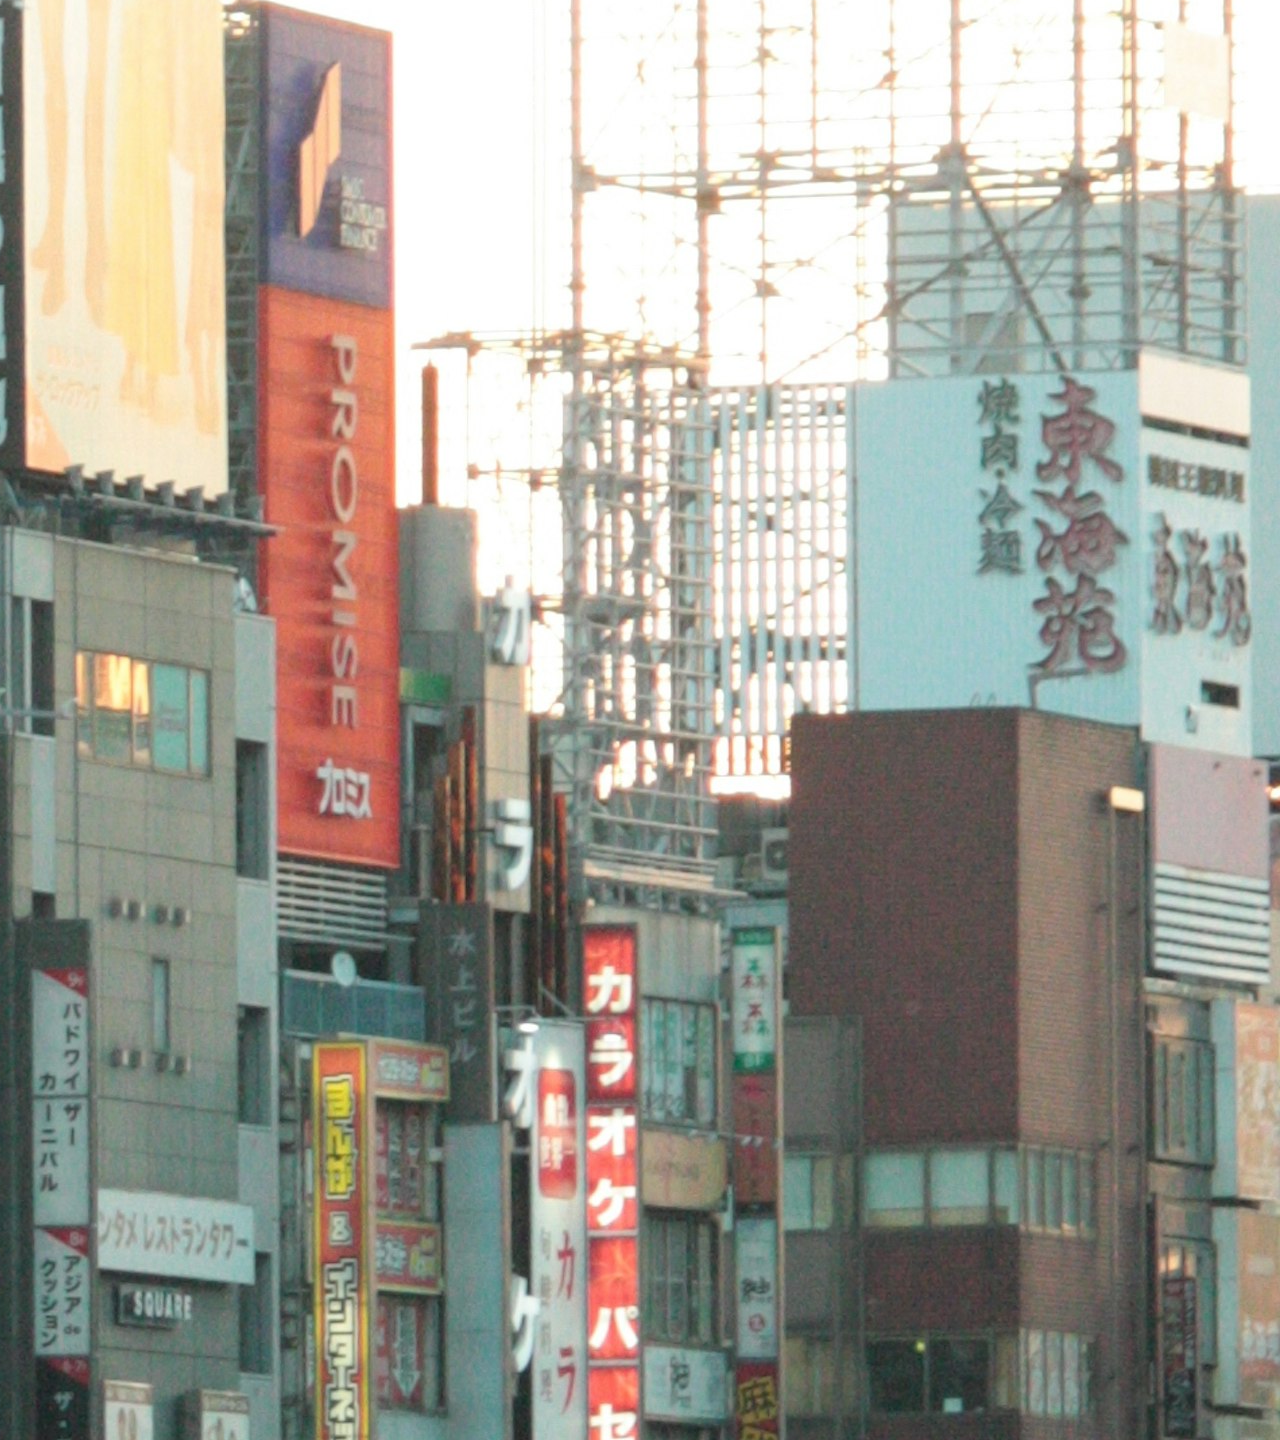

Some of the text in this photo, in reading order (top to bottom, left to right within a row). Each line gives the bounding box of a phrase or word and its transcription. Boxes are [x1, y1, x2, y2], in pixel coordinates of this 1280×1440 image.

[328, 332, 359, 731] PROMISE
[1032, 375, 1125, 674] 東海苑
[62, 1003, 83, 1146] バドワイザー
[39, 1072, 61, 1192] カーニバル
[63, 1255, 83, 1316] アジア
[141, 1214, 250, 1260] レストランタワー
[38, 1259, 59, 1349] クッション
[133, 1291, 195, 1322] SQUARE
